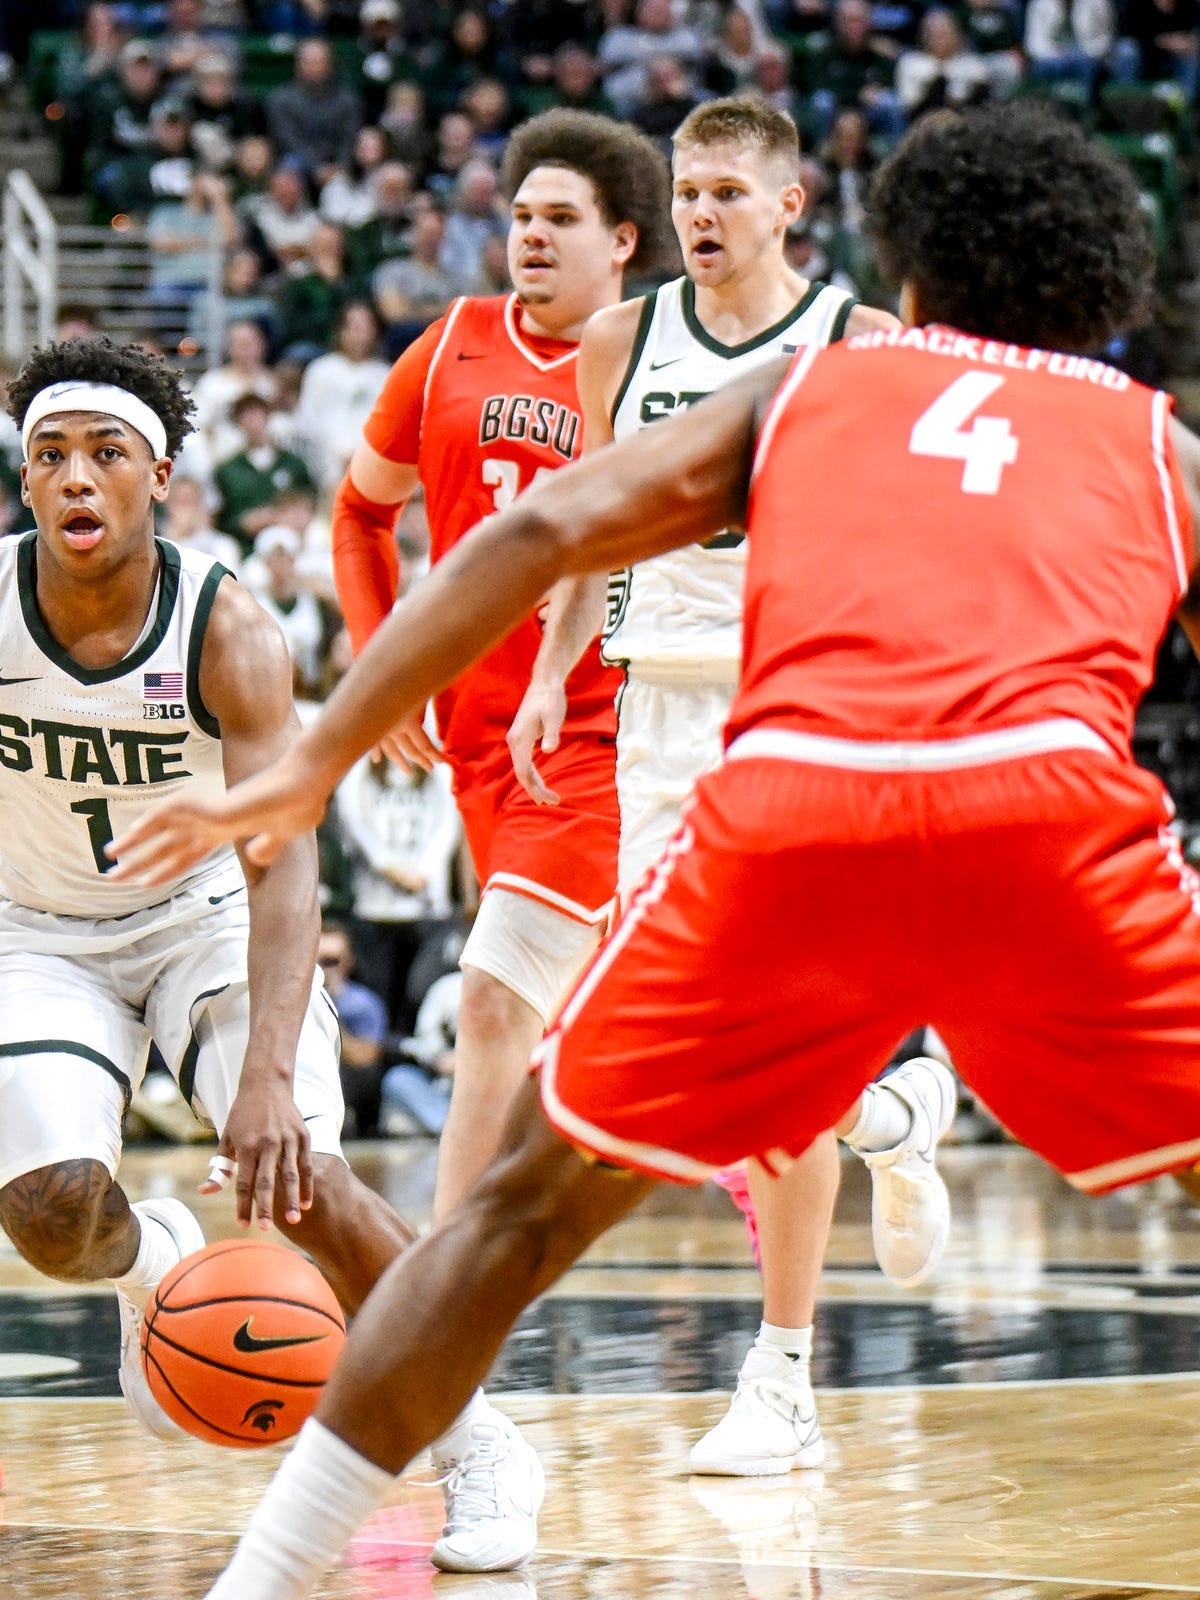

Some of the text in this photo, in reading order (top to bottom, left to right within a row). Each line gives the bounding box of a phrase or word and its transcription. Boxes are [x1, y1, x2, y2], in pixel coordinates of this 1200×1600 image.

[478, 394, 581, 461] BGSU
[908, 370, 1019, 495] 4
[70, 798, 118, 874] 1
